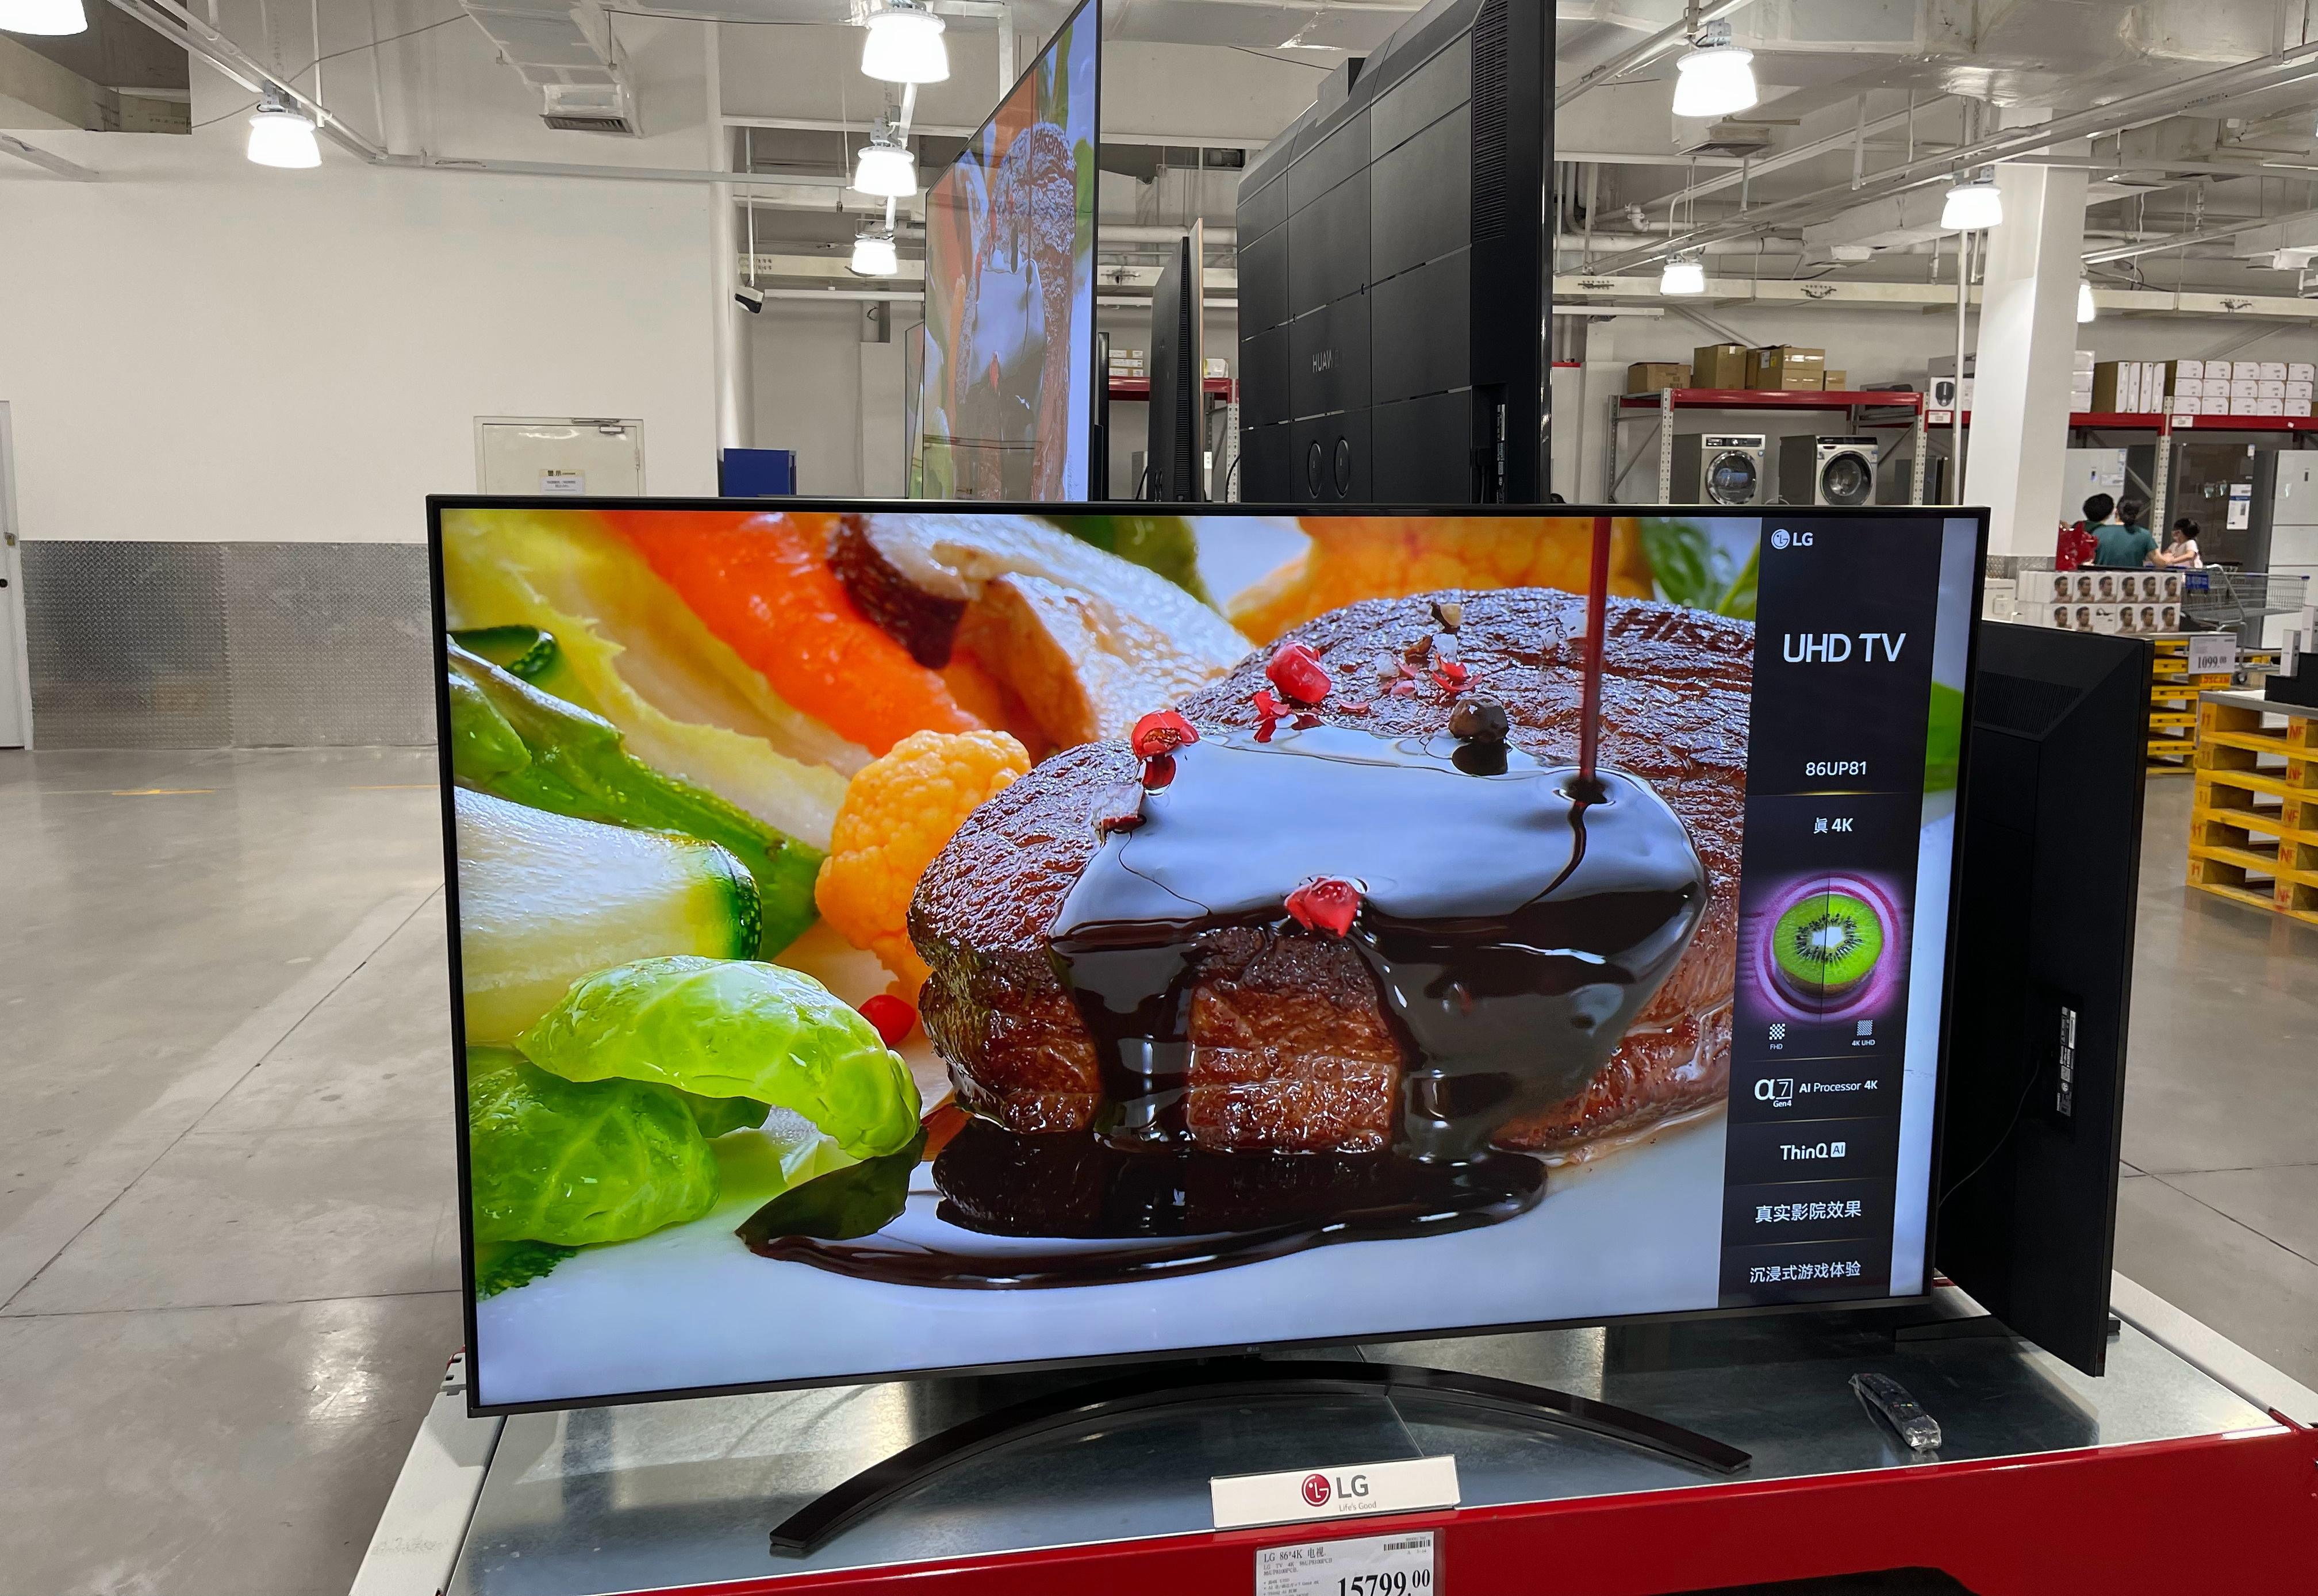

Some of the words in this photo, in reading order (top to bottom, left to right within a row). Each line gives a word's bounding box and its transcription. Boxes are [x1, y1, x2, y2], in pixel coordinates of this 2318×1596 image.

[1793, 532, 1813, 546] LG
[1783, 633, 1852, 663] UHD
[1858, 633, 1907, 662] TV
[1806, 761, 1867, 776] 86UP81
[1831, 818, 1853, 832] 4K
[1799, 1083, 1811, 1094] AI
[1813, 1083, 1862, 1092] Processor
[1864, 1080, 1878, 1090] 4K
[1780, 1142, 1829, 1161] ThinQ
[1755, 1200, 1862, 1223] 真实影院效果
[1749, 1260, 1862, 1283] 沉浸式游戏体验
[1336, 1475, 1369, 1499] LG
[1339, 1502, 1357, 1512] Life's
[1358, 1501, 1377, 1510] Good
[1264, 1552, 1275, 1563] LG
